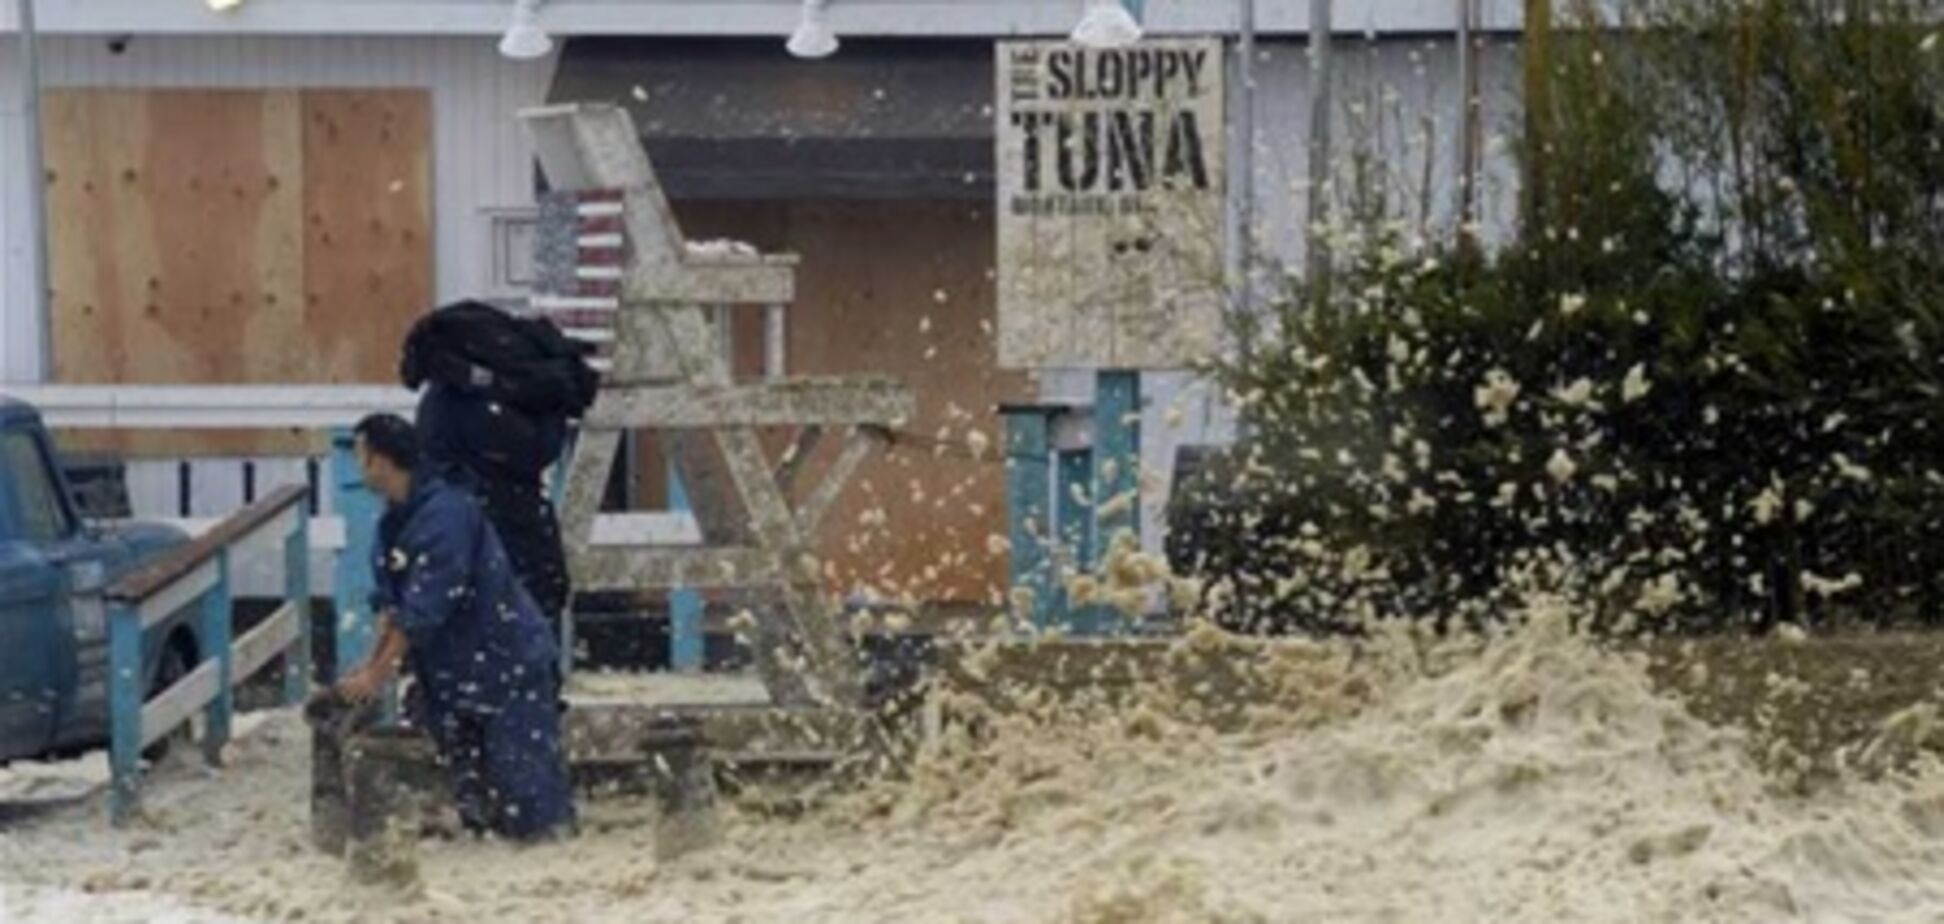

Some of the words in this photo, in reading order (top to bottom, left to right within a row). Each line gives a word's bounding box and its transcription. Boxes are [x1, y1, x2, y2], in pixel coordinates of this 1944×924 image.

[1010, 49, 1039, 100] THE
[1047, 49, 1207, 99] SLOPPY
[1011, 110, 1210, 191] TUNA
